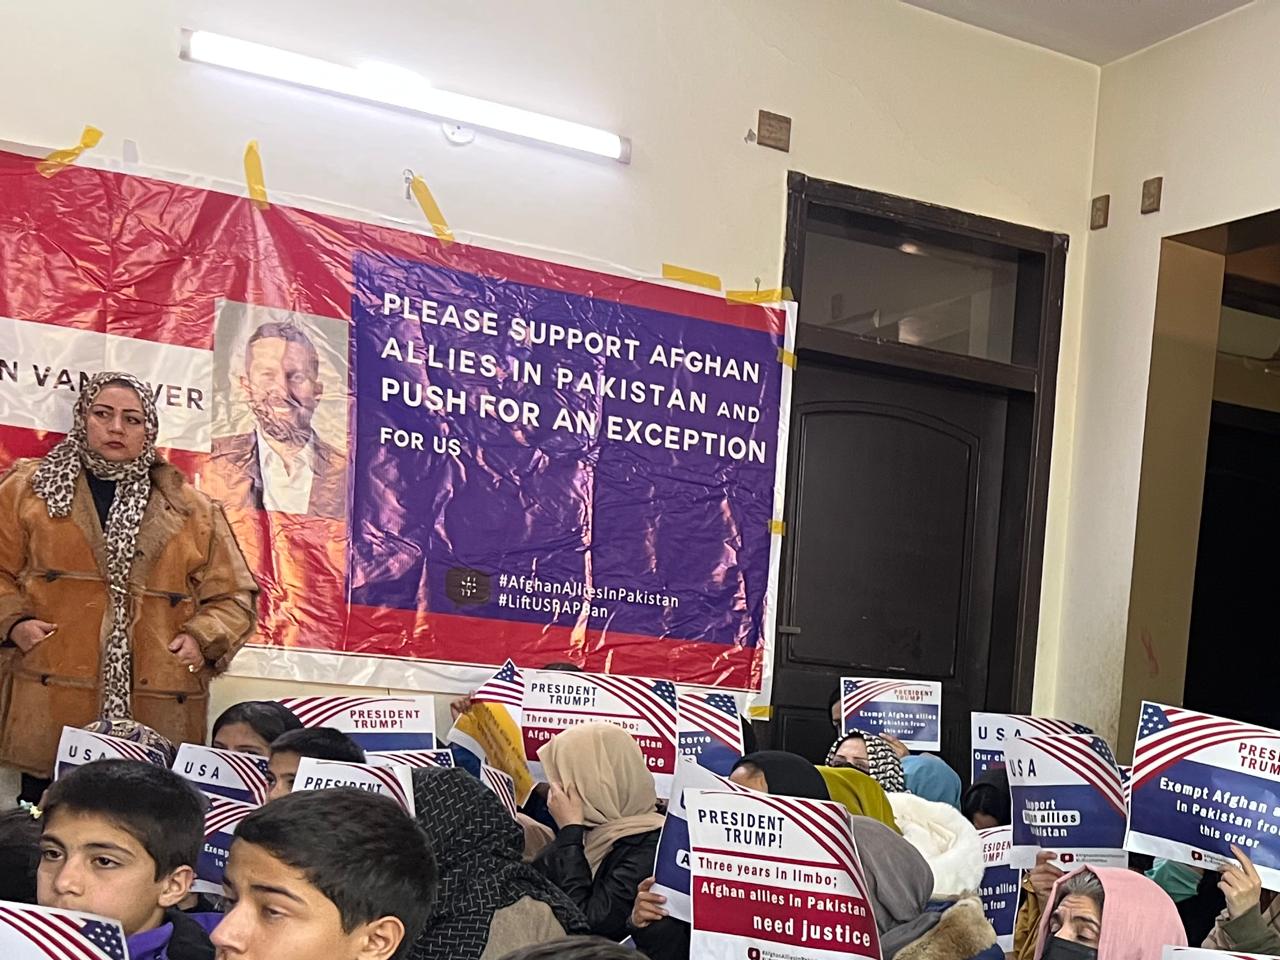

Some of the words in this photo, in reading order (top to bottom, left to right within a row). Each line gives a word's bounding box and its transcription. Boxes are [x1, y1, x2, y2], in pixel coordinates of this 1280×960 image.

[383, 293, 498, 336] PLEASE
[510, 317, 639, 359] SUPPORT
[650, 345, 761, 383] AFGHAN
[382, 337, 498, 378] ALLIES
[514, 360, 541, 386] IN
[556, 368, 707, 413] PAKISTAN
[717, 401, 760, 423] AND
[381, 378, 468, 415] PUSH
[478, 397, 539, 428] FOR
[553, 408, 597, 436] AN
[607, 415, 766, 463] EXCEPTION
[381, 427, 424, 450] FOR
[433, 434, 461, 456] US
[531, 683, 598, 696] PRESIDENT
[350, 709, 420, 720] PRESIDENT
[526, 714, 554, 723] Three
[184, 762, 219, 779] USA
[1160, 777, 1209, 799] Exempt
[1213, 790, 1268, 813] Afghan
[698, 809, 784, 831] PRESIDENT
[725, 827, 783, 848] TRUMP!
[1225, 833, 1259, 849] order
[698, 857, 733, 872] Three
[737, 864, 770, 878] years
[701, 881, 745, 898] Afghan
[750, 889, 784, 905] allies
[808, 896, 866, 916] Pakistan
[753, 915, 794, 935] need
[801, 920, 871, 947] justice
